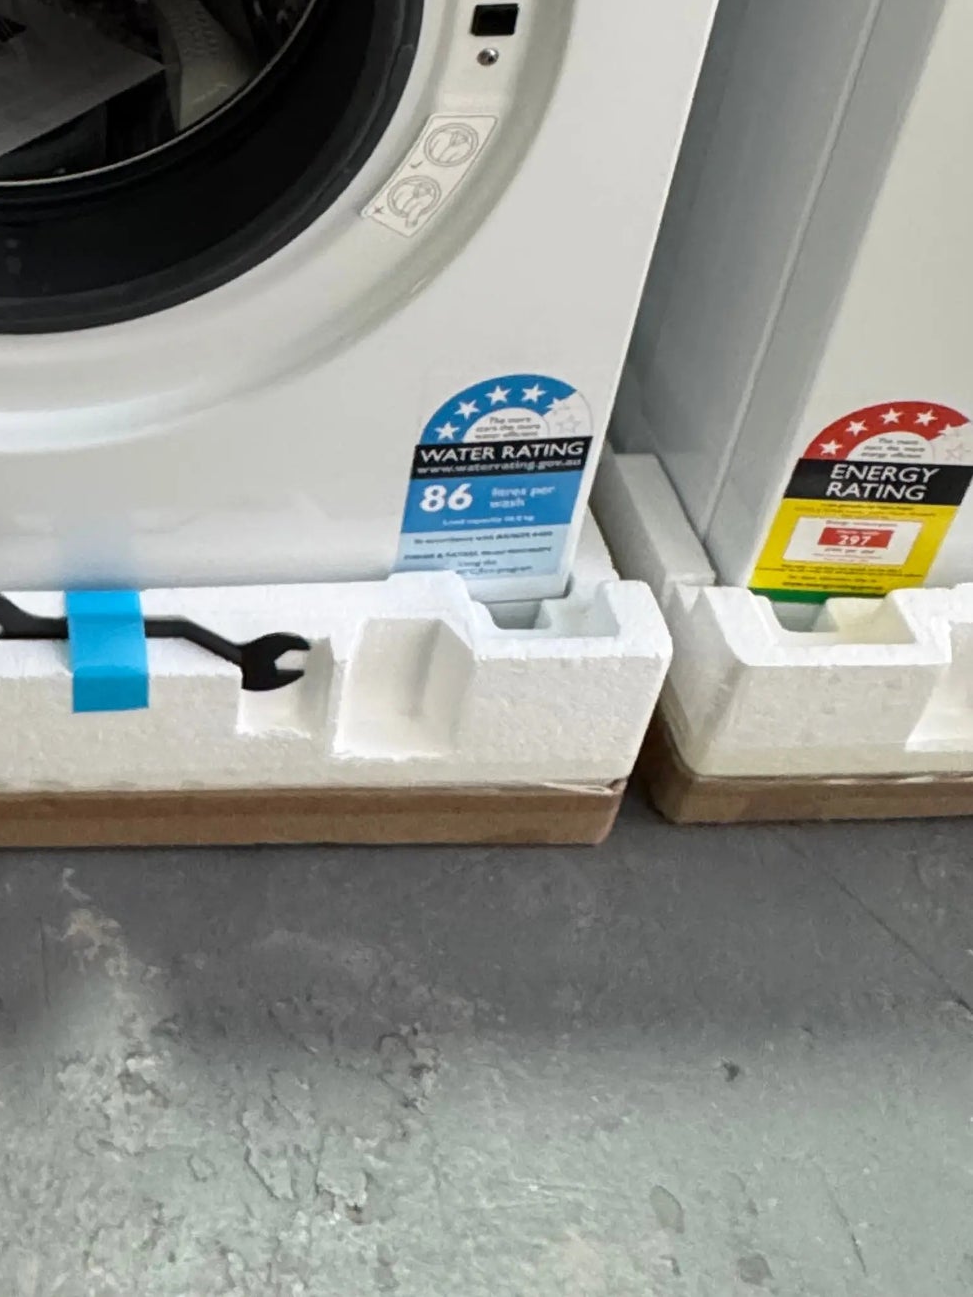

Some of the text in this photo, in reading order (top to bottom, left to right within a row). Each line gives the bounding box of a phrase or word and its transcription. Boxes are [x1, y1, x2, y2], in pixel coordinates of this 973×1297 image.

[420, 441, 585, 463] WATER RATING
[416, 458, 582, 475] www.waterrating.gov.au
[830, 464, 940, 484] ENERGY
[419, 483, 473, 513] 86
[825, 483, 927, 501] RATING
[489, 497, 525, 508] wash
[838, 535, 872, 546] 297
